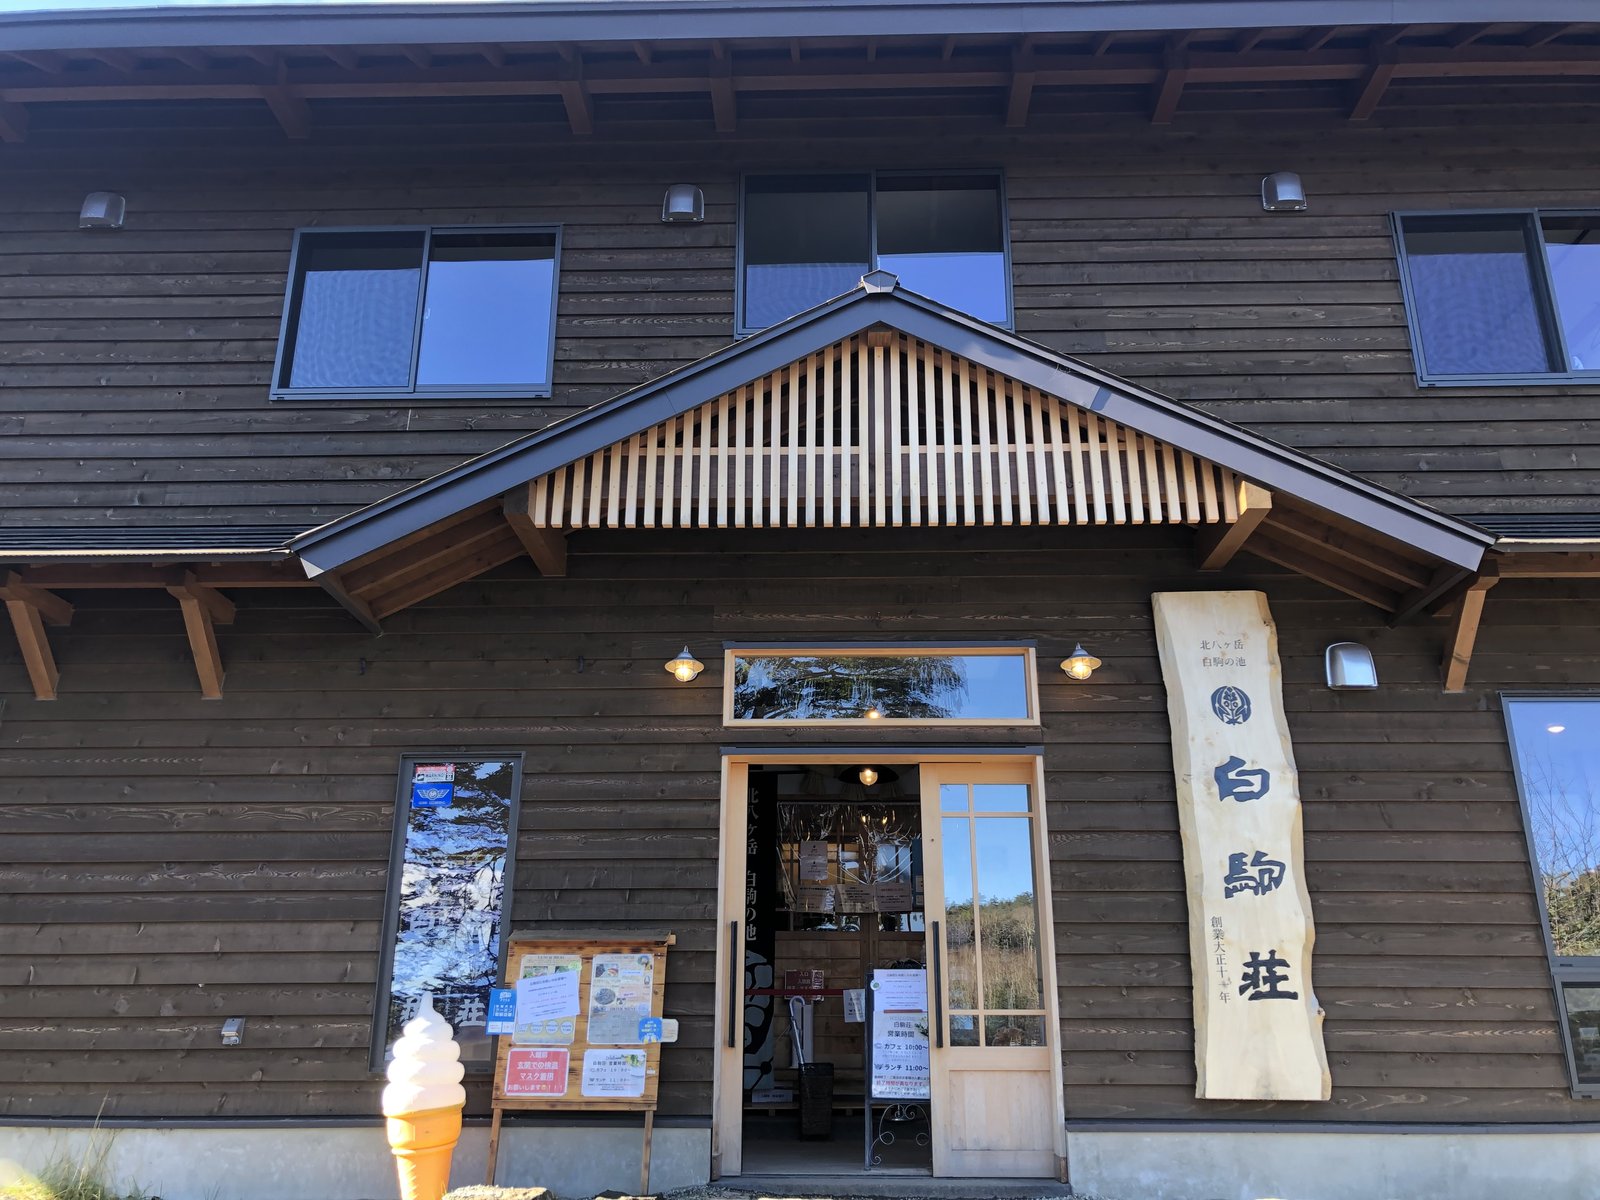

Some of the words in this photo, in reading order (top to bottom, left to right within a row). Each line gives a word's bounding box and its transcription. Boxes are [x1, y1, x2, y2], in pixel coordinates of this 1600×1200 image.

[1200, 639, 1244, 650] 北八ヶ岳
[1202, 656, 1247, 667] 白駒の池
[1213, 755, 1299, 1001] 白駒荘
[887, 1030, 915, 1038] 営業時間
[519, 1072, 555, 1081] マスク着用
